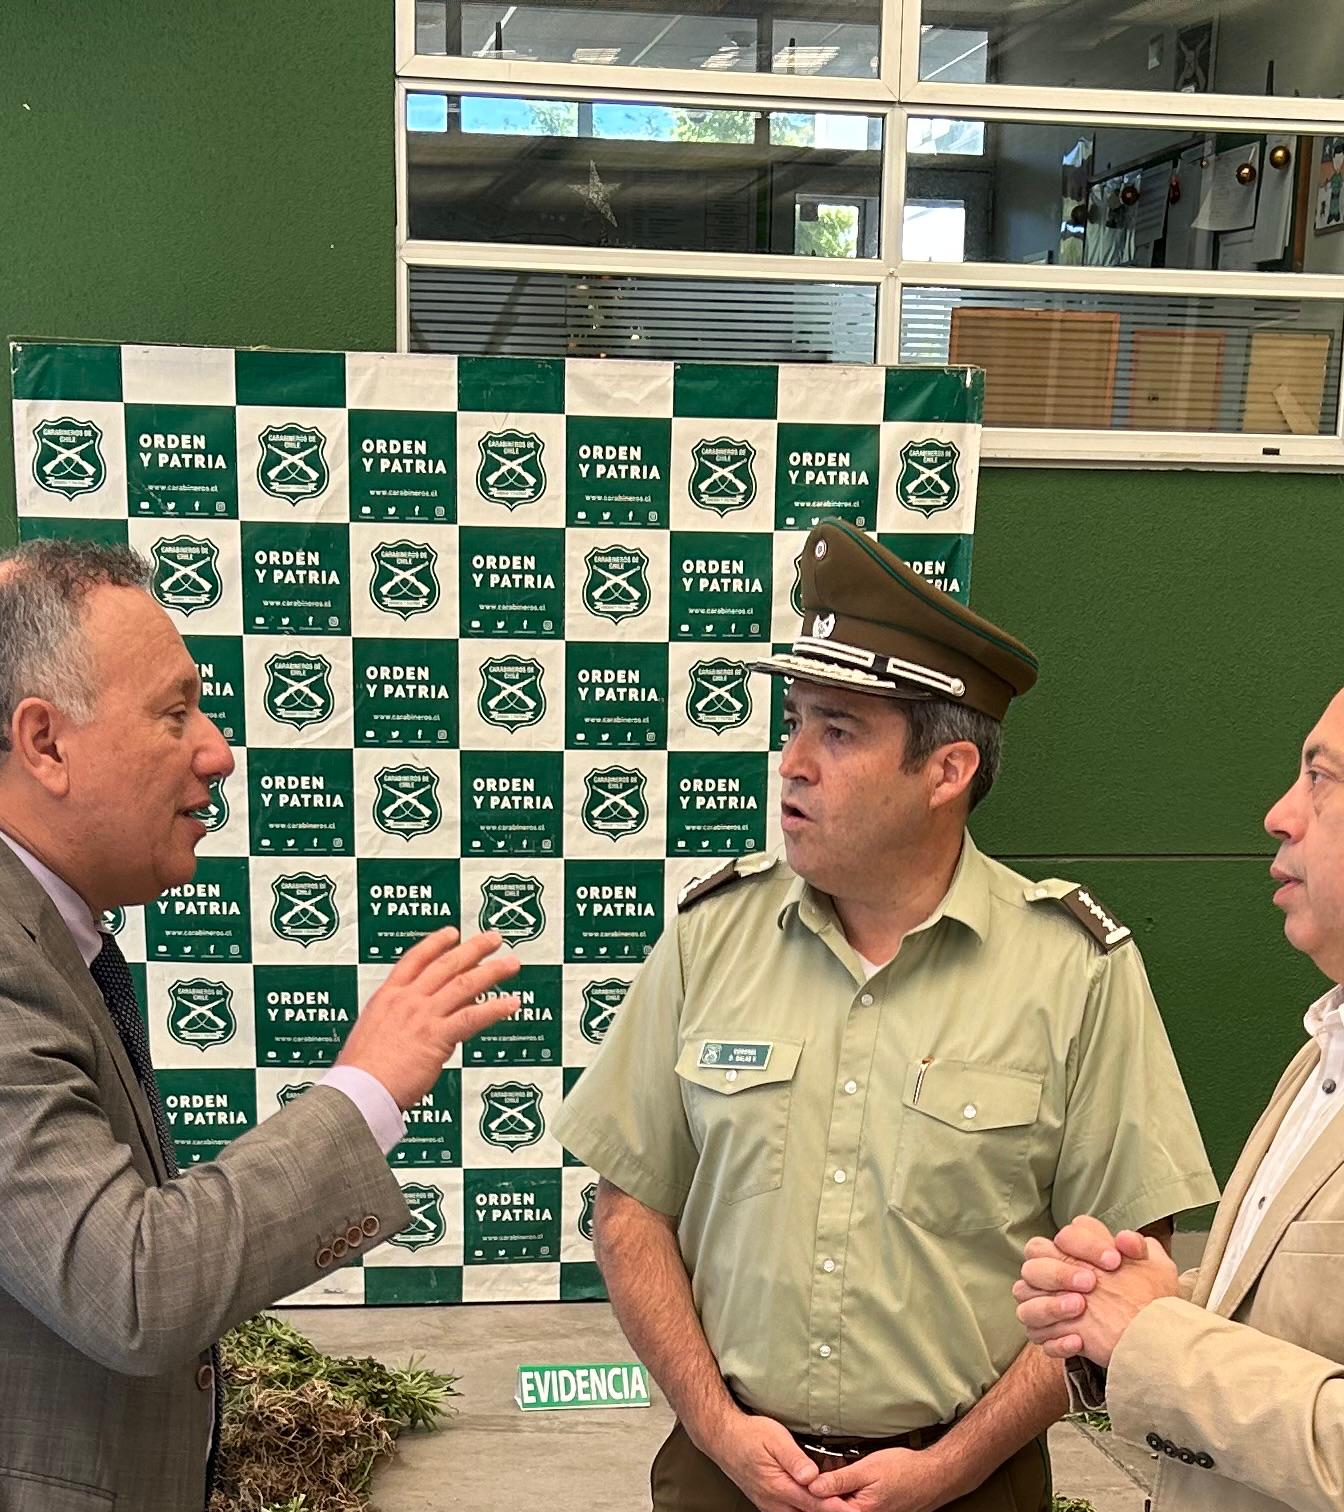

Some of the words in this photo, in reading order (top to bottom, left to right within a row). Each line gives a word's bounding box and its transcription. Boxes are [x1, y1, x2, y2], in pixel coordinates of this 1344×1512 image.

[139, 434, 205, 449] ORDEN
[362, 440, 426, 454] ORDEN
[579, 445, 641, 460] ORDEN
[789, 452, 850, 467] ORDEN
[140, 453, 152, 467] Y
[159, 453, 226, 468] PATRIA
[362, 458, 373, 472] Y
[381, 458, 446, 474] PATRIA
[579, 464, 590, 477] Y
[596, 464, 660, 479] PATRIA
[789, 470, 799, 484] Y
[806, 471, 868, 485] PATRIA
[255, 550, 319, 565] ORDEN
[472, 555, 535, 570] ORDEN
[683, 560, 743, 574] ORDEN
[903, 561, 945, 574] DEN
[255, 569, 266, 583] Y
[274, 570, 340, 584] PATRIA
[472, 574, 483, 587] Y
[490, 574, 554, 588] PATRIA
[682, 578, 693, 591] Y
[700, 578, 762, 592] PATRIA
[366, 666, 428, 680] ORDEN
[578, 670, 639, 683] ORDEN
[202, 682, 234, 696] RIA
[366, 684, 377, 697] Y
[384, 684, 449, 698] PATRIA
[578, 687, 588, 700] Y
[596, 688, 658, 701] PATRIA
[261, 776, 324, 789] ORDEN
[473, 778, 534, 791] ORDEN
[680, 779, 739, 791] ORDEN
[261, 794, 272, 806] Y
[280, 794, 343, 807] PATRIA
[473, 796, 484, 808] Y
[490, 796, 553, 809] PATRIA
[680, 796, 690, 809] Y
[696, 796, 757, 809] PATRIA
[370, 886, 431, 898] ORDEN
[577, 886, 636, 899] ORDEN
[157, 901, 168, 914] Y
[175, 902, 240, 915] PATRIA
[371, 903, 381, 915] Y
[388, 903, 451, 915] PATRIA
[576, 904, 587, 916] Y
[594, 904, 654, 916] PATRIA
[267, 992, 328, 1004] ORDEN
[268, 1009, 278, 1021] Y
[285, 1009, 348, 1021] PATRIA
[166, 1095, 227, 1108] ORDEN
[167, 1112, 177, 1124] Y
[184, 1113, 247, 1124] PATRIA
[402, 1110, 452, 1122] ATRIA
[476, 1193, 534, 1205] ORDEN
[476, 1210, 486, 1221] Y
[492, 1209, 552, 1221] PATRIA
[522, 1367, 647, 1403] EVIDENCIA
